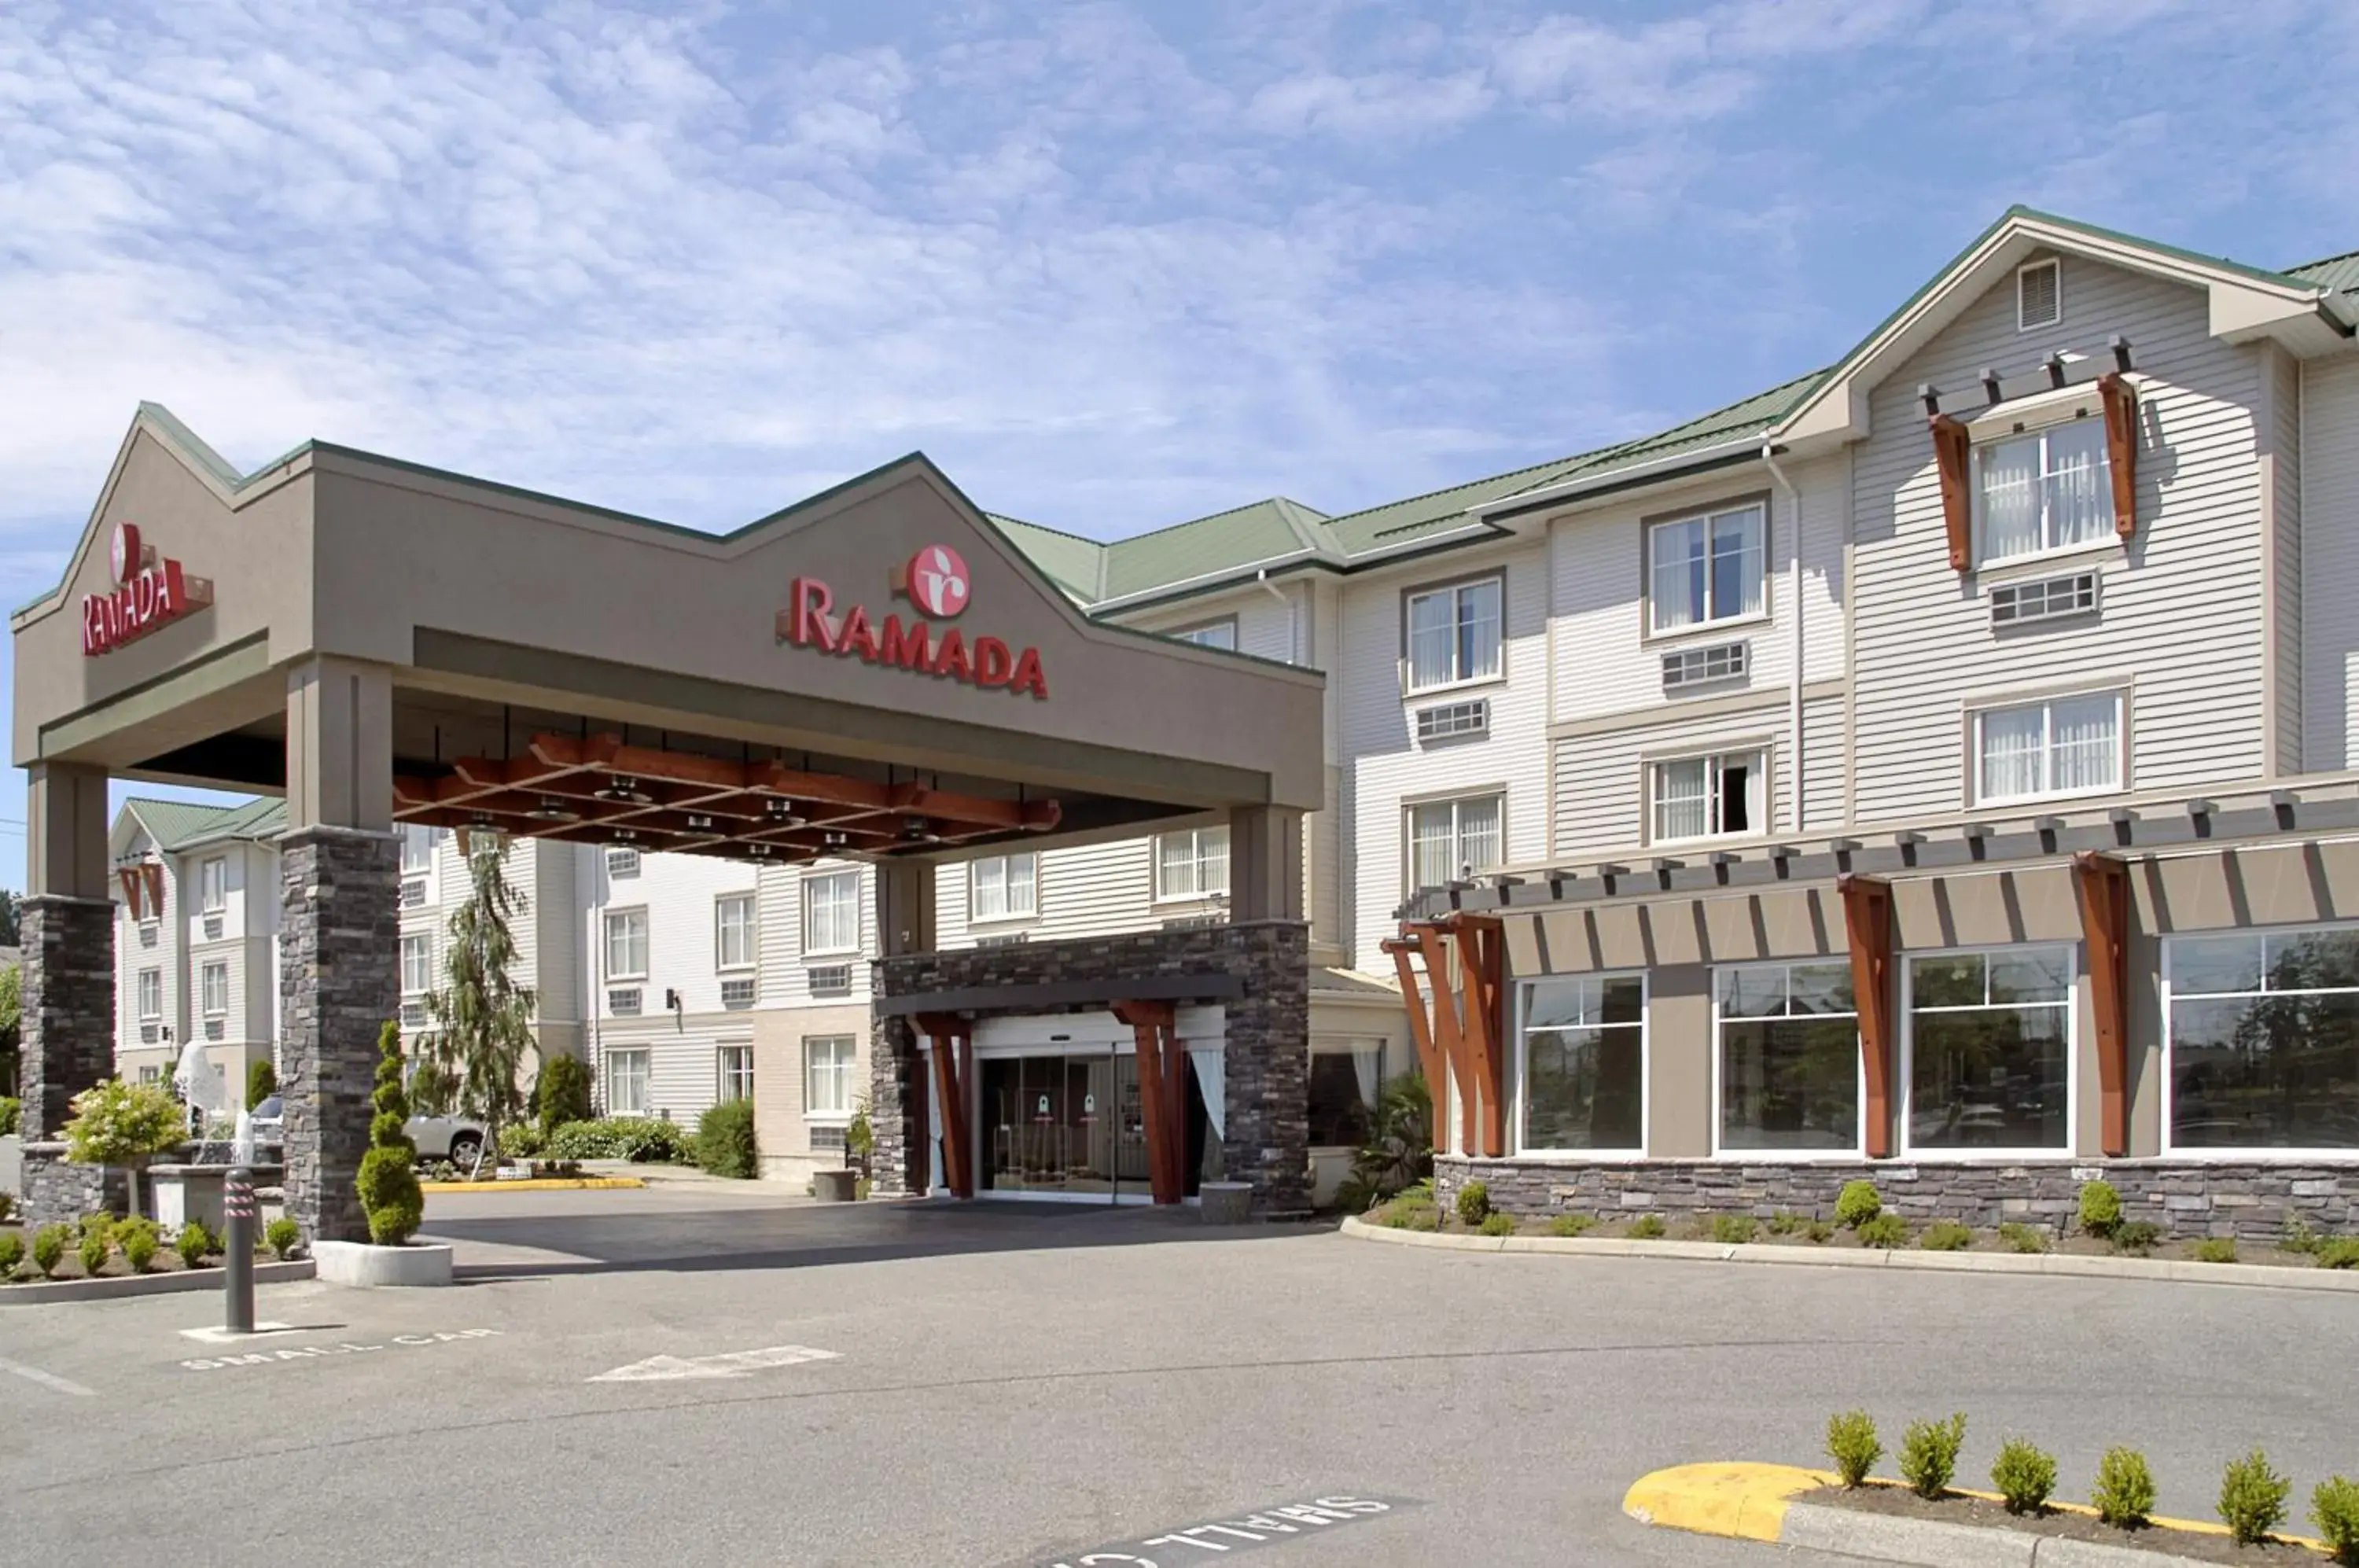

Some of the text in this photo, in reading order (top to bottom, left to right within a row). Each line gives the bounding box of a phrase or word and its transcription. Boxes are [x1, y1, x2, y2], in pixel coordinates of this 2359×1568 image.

[789, 576, 1049, 700] RAMADA
[180, 1328, 505, 1371] SMALL CAR
[1142, 1496, 1391, 1551] SMALL
